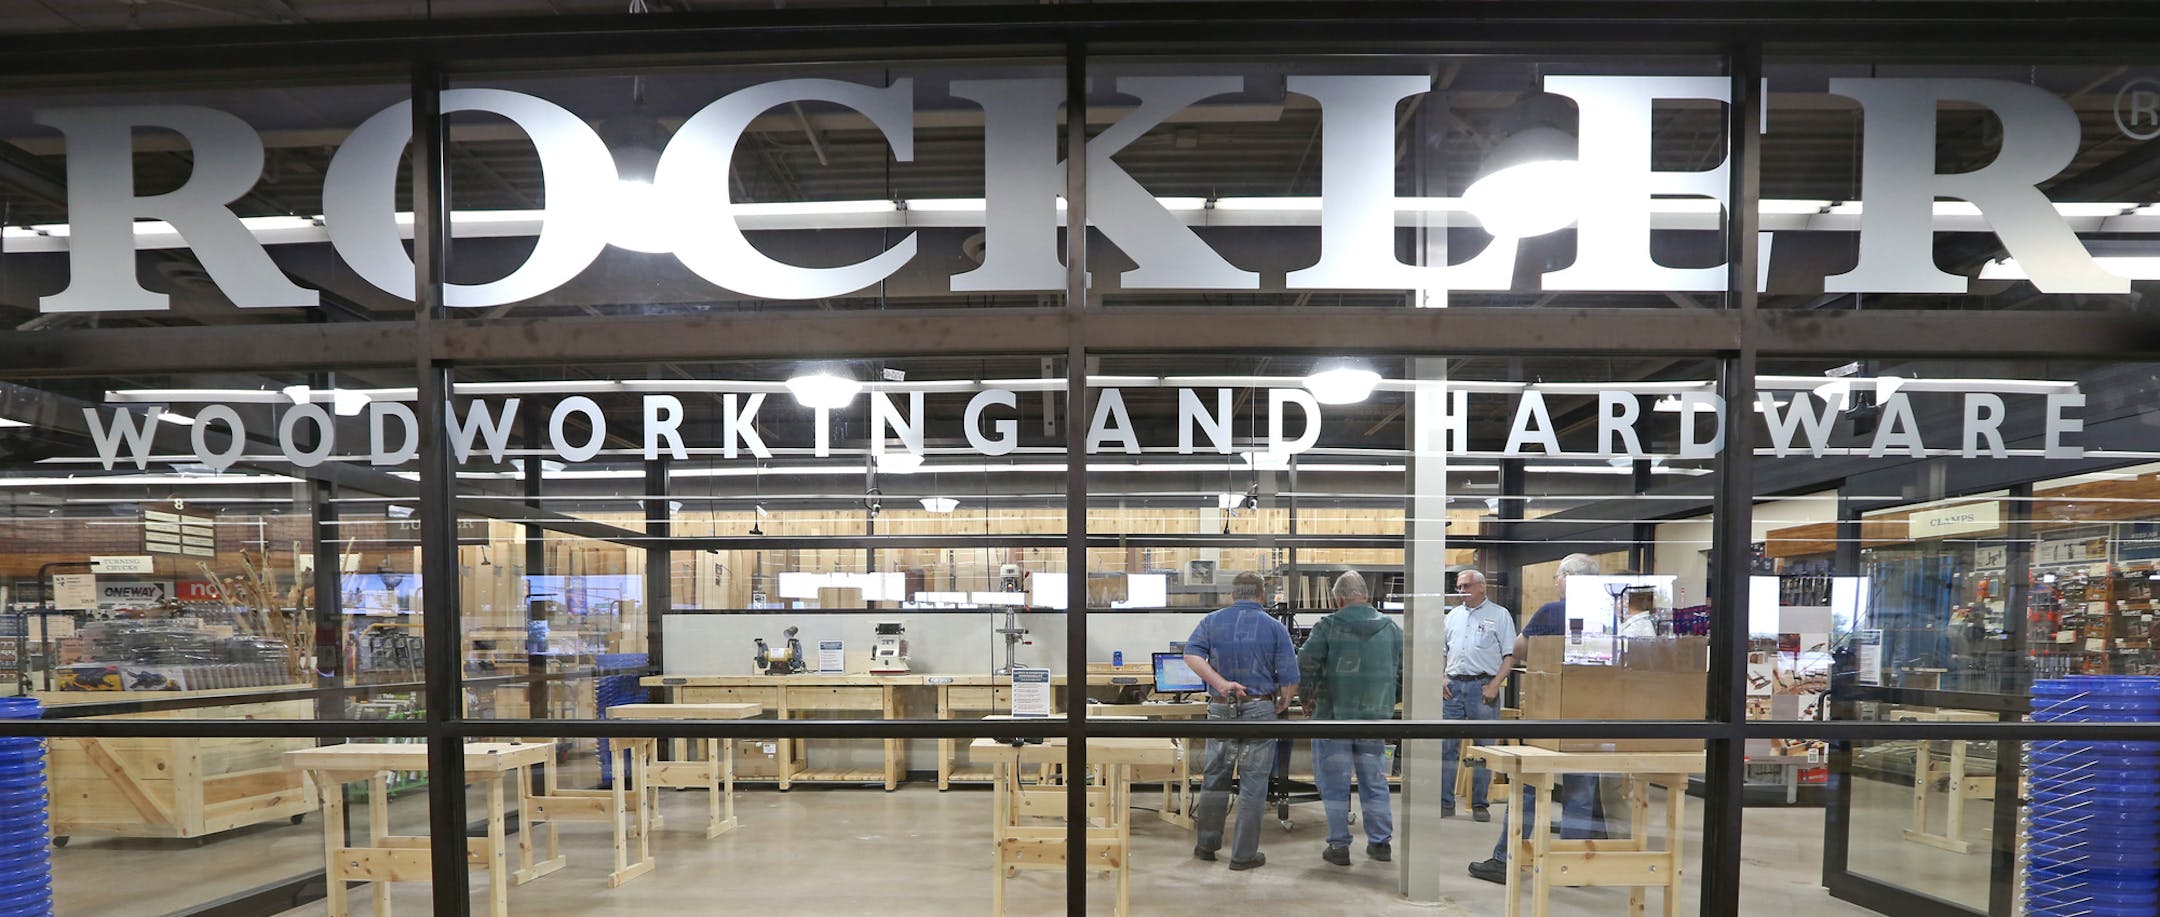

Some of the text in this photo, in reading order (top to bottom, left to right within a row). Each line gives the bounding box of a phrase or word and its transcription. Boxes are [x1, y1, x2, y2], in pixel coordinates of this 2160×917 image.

[32, 75, 2132, 313] ROCKLER
[82, 387, 2087, 472] WOODWORKING AND HARDWARE
[174, 498, 185, 510] 8
[1929, 513, 1975, 527] CLAMPS
[104, 586, 157, 598] ONEWAY
